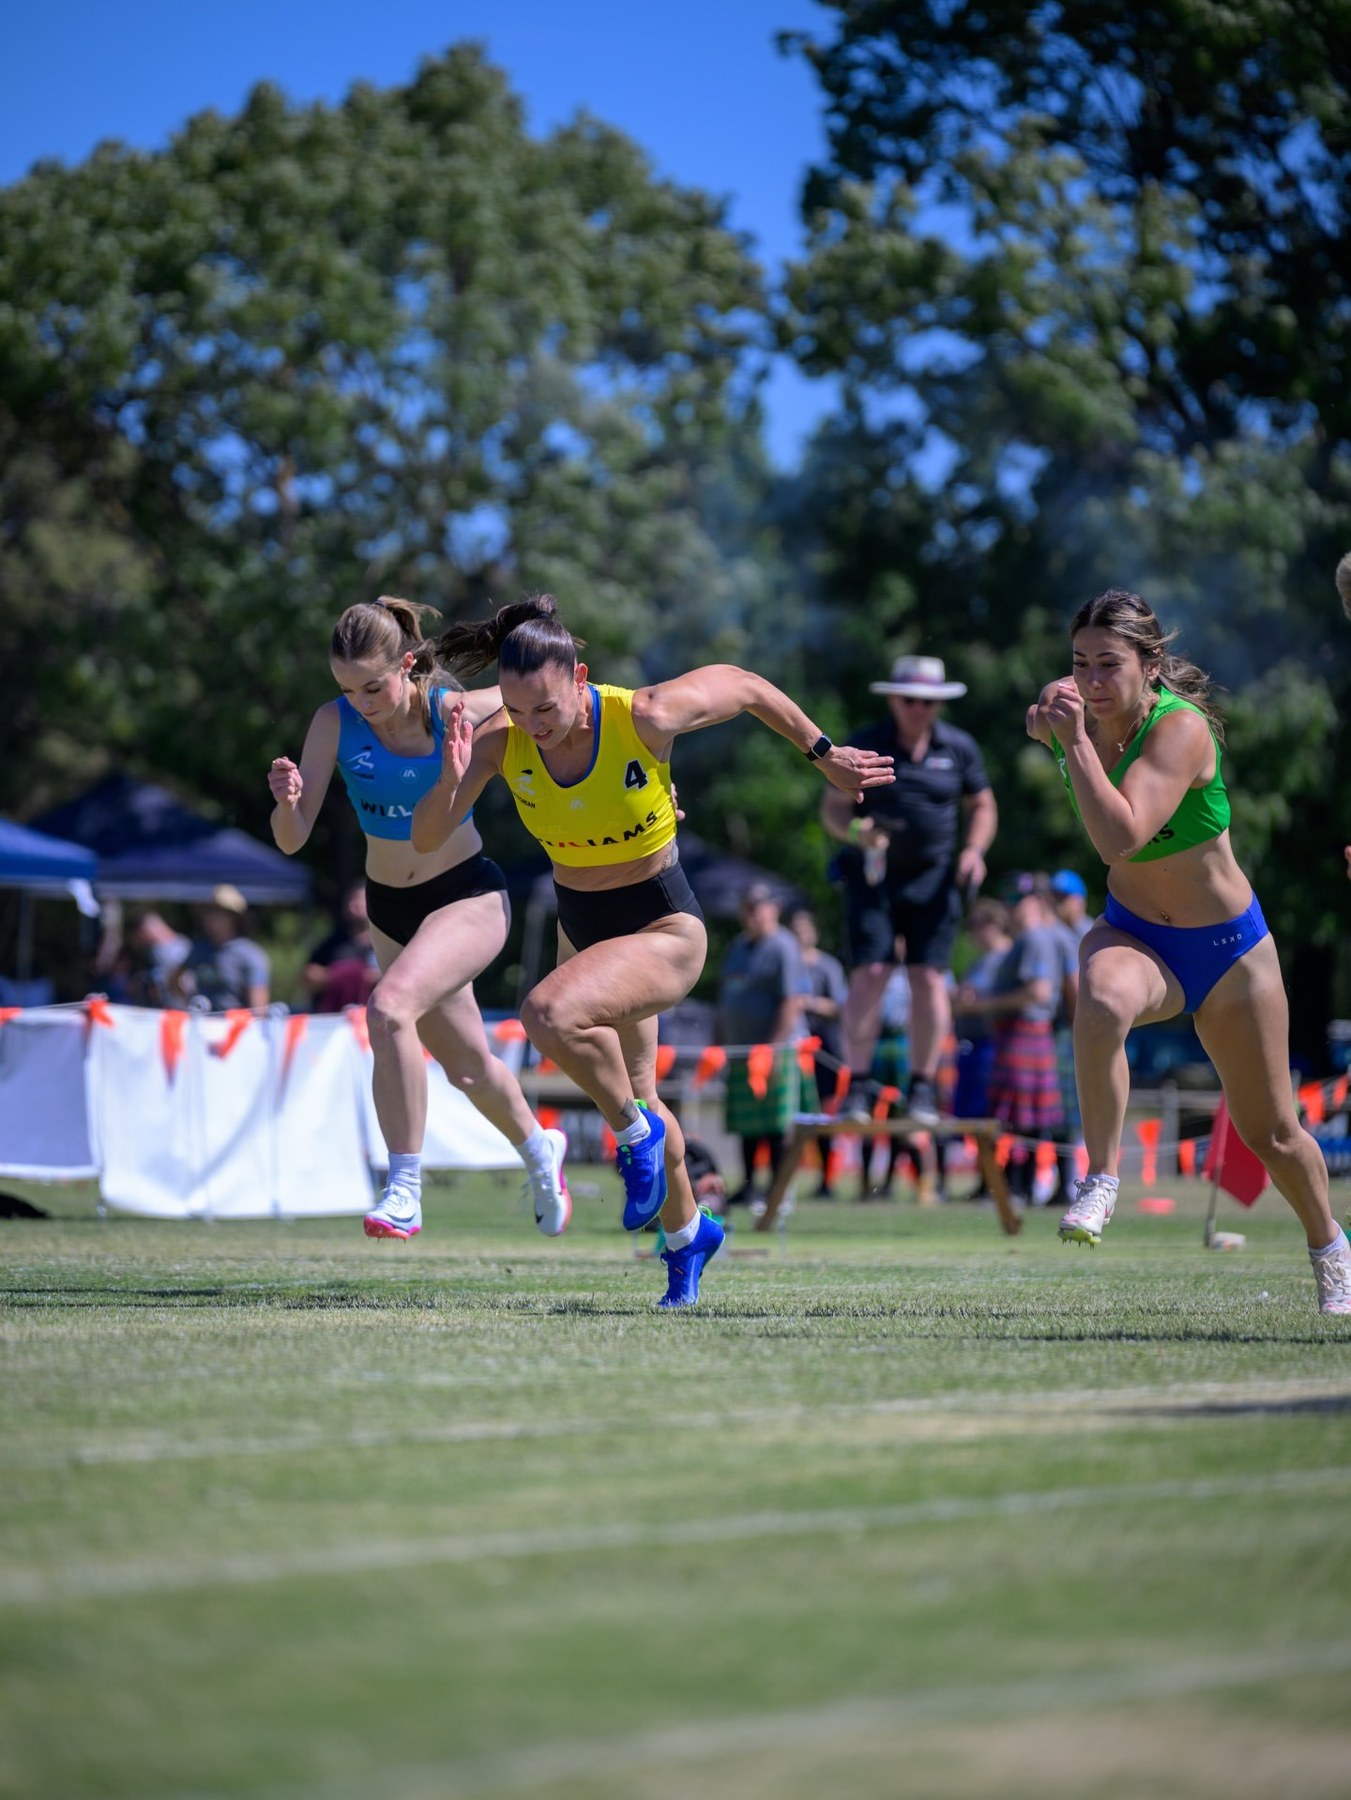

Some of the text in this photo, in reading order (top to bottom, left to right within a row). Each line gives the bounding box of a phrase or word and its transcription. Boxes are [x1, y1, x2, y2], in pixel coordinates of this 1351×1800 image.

[624, 758, 648, 790] 4
[360, 797, 416, 818] WILL
[539, 811, 658, 847] LIAMS
